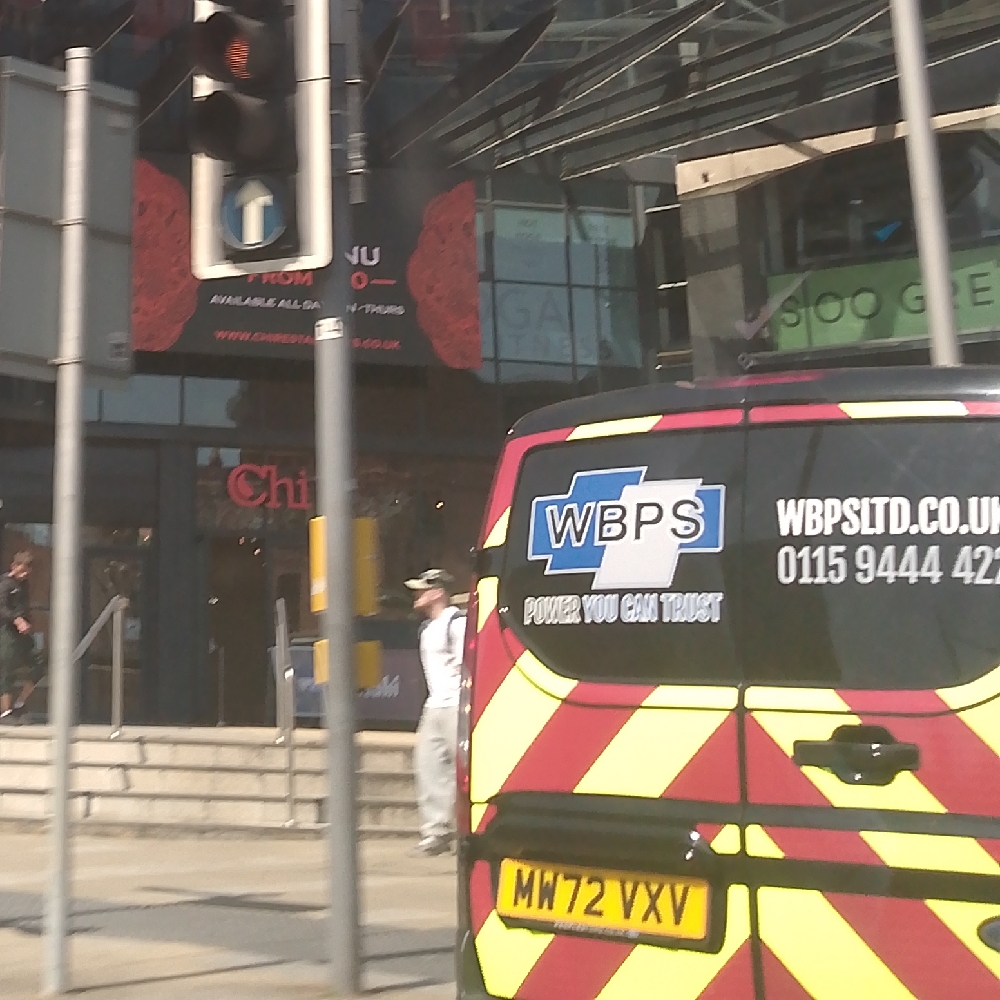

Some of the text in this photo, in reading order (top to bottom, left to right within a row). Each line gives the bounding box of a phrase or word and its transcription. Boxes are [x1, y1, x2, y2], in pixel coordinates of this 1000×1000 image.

[302, 300, 321, 310] DA
[548, 499, 703, 546] WBPS
[777, 545, 847, 585] 0115
[854, 545, 943, 585] 9444
[523, 592, 723, 626] POWER YOU CAN TRUST
[513, 868, 691, 927] MW72 VXV
